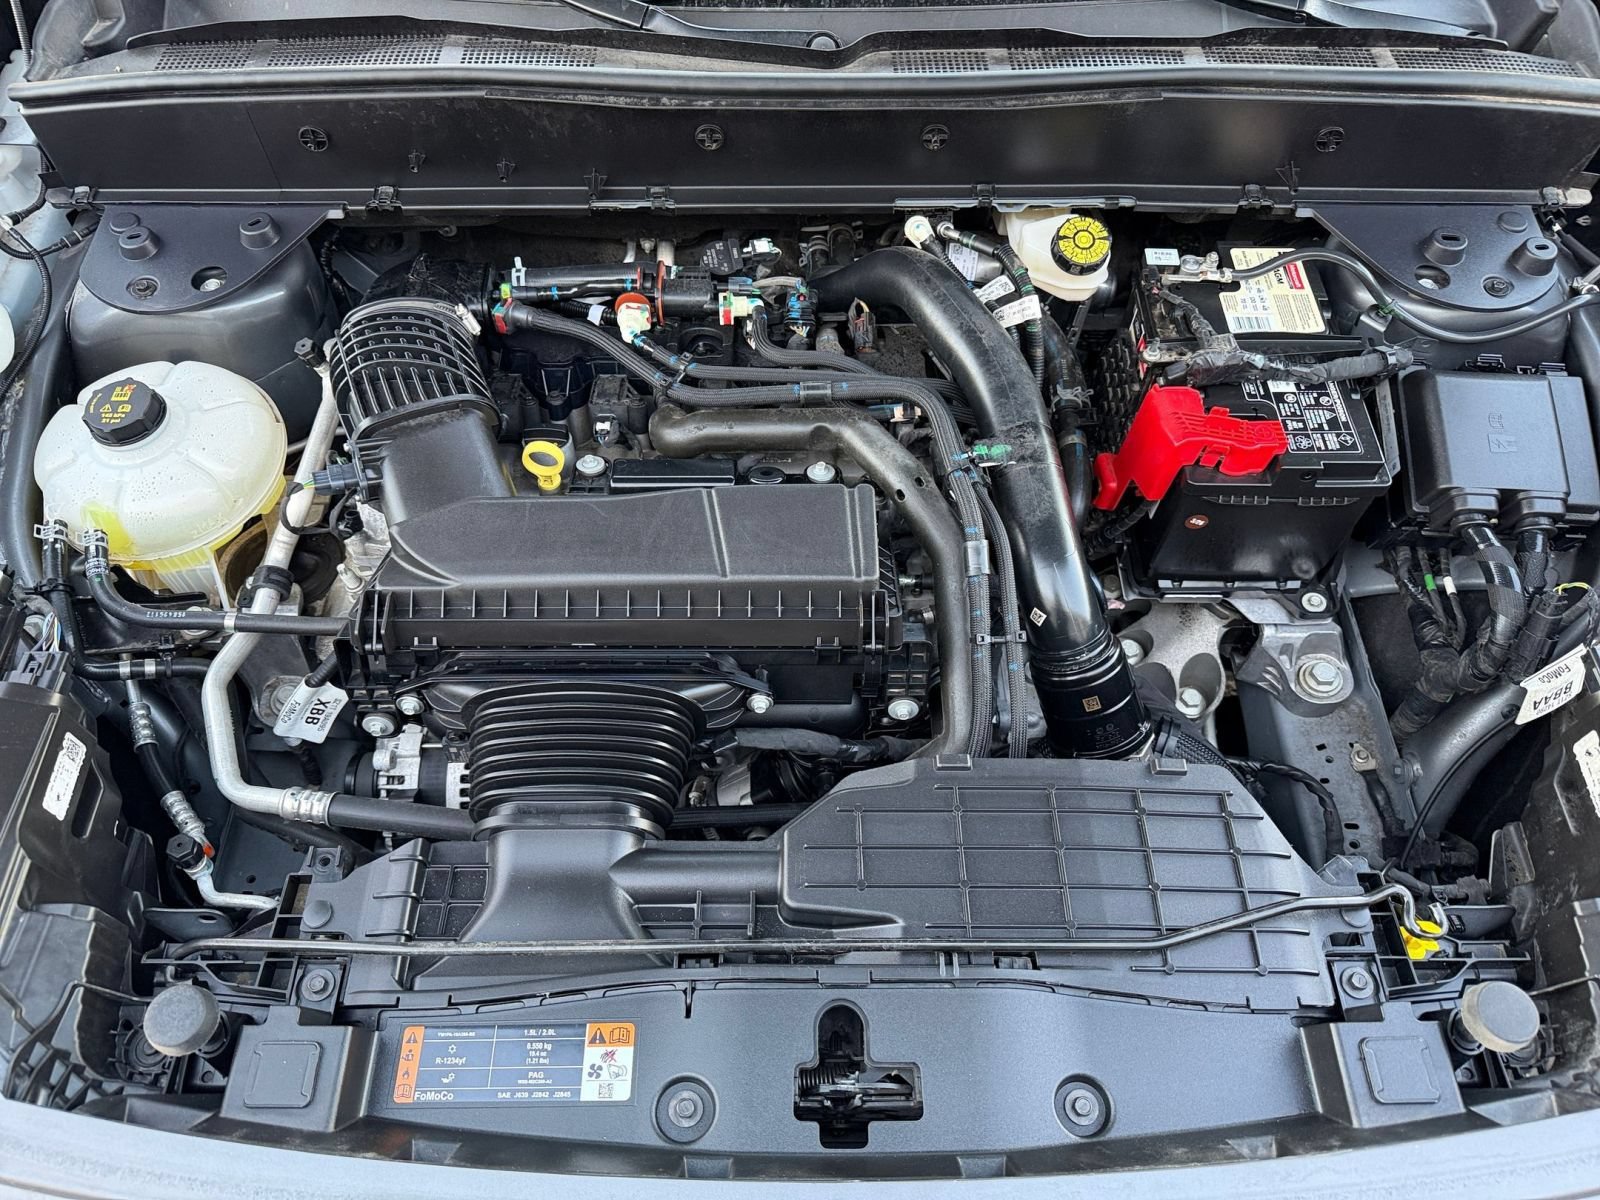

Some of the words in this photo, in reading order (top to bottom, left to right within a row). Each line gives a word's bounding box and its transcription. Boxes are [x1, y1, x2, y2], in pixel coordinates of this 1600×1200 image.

[1538, 663, 1572, 684] FoMoCo
[1533, 680, 1574, 710] BBAA
[281, 700, 301, 724] FoMoCo
[305, 698, 331, 725] XBB
[543, 1042, 552, 1051] kg
[435, 1057, 467, 1066] R-1234yf
[528, 1071, 544, 1079] PAG
[414, 1091, 454, 1101] FoMoCo
